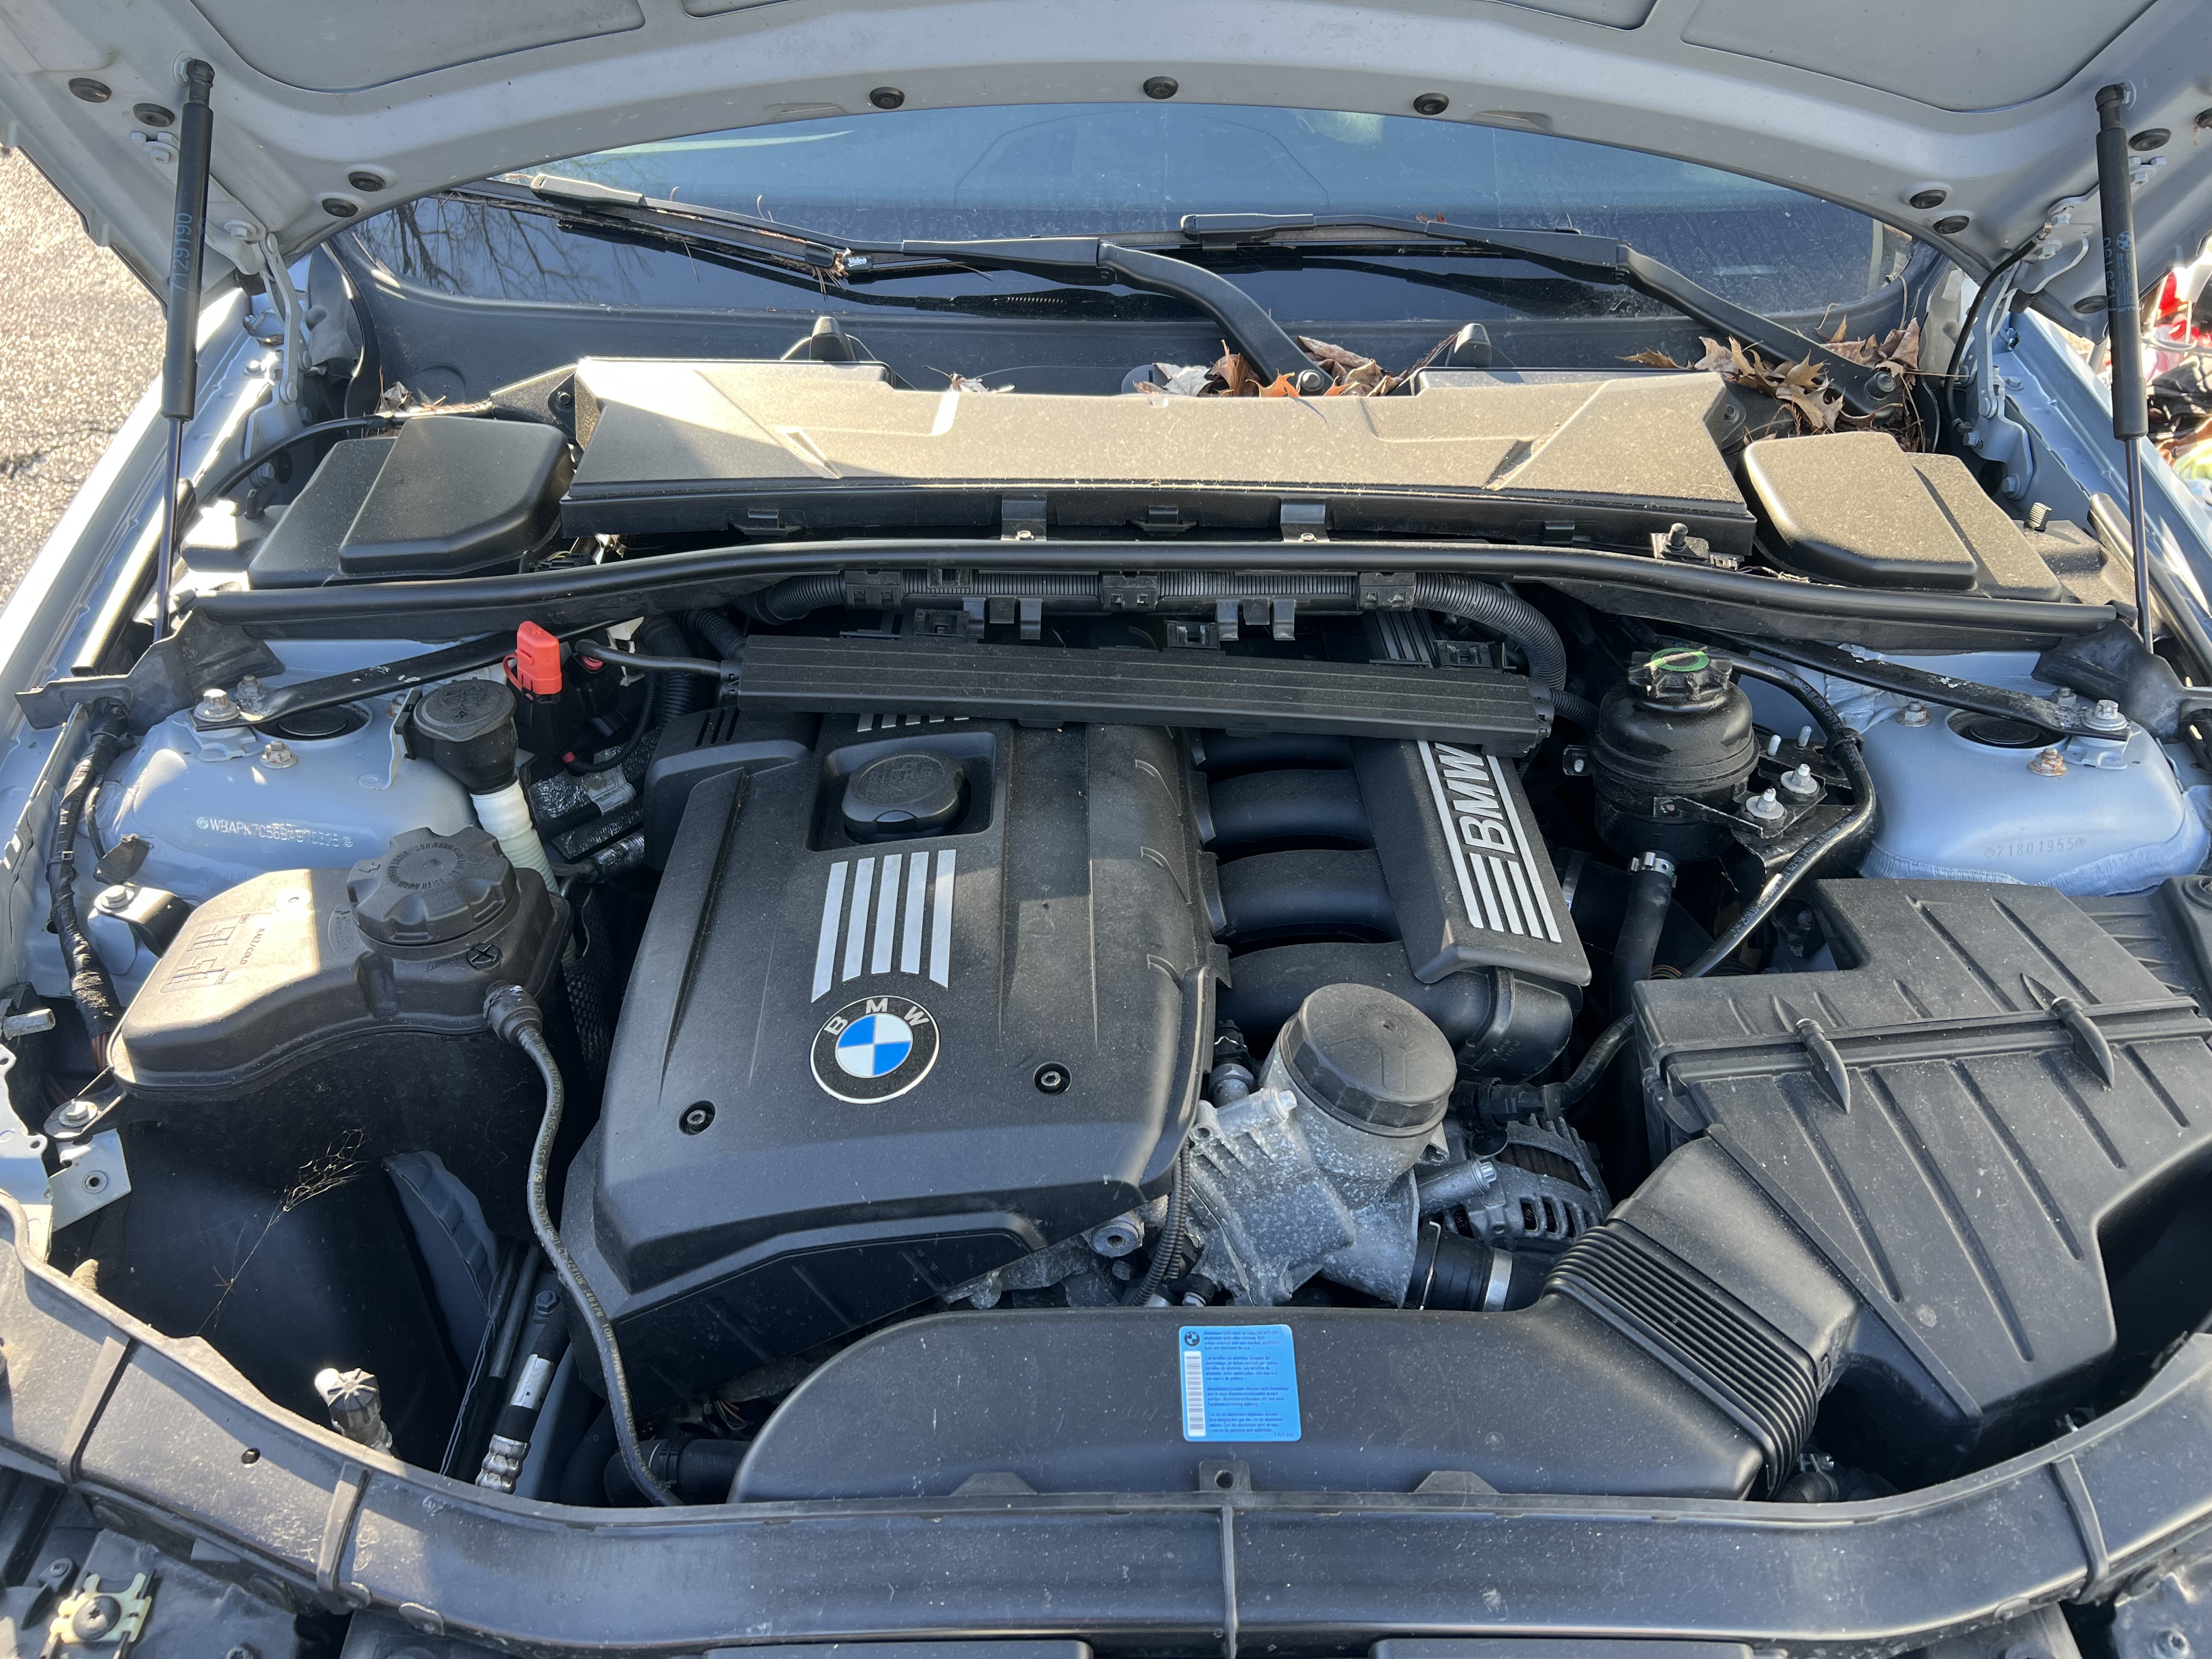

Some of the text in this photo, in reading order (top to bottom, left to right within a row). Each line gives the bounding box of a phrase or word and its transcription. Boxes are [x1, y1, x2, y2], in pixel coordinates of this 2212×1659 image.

[171, 212, 193, 291] 7129190
[1434, 742, 1515, 854] BMW
[210, 818, 339, 848] WBAPK7C56BA970325
[1996, 837, 2074, 857] 21801955
[240, 913, 250, 924] min
[239, 928, 266, 964] KALT/COLD
[217, 971, 229, 985] max
[824, 997, 930, 1036] BMW
[601, 1323, 614, 1342] 10H
